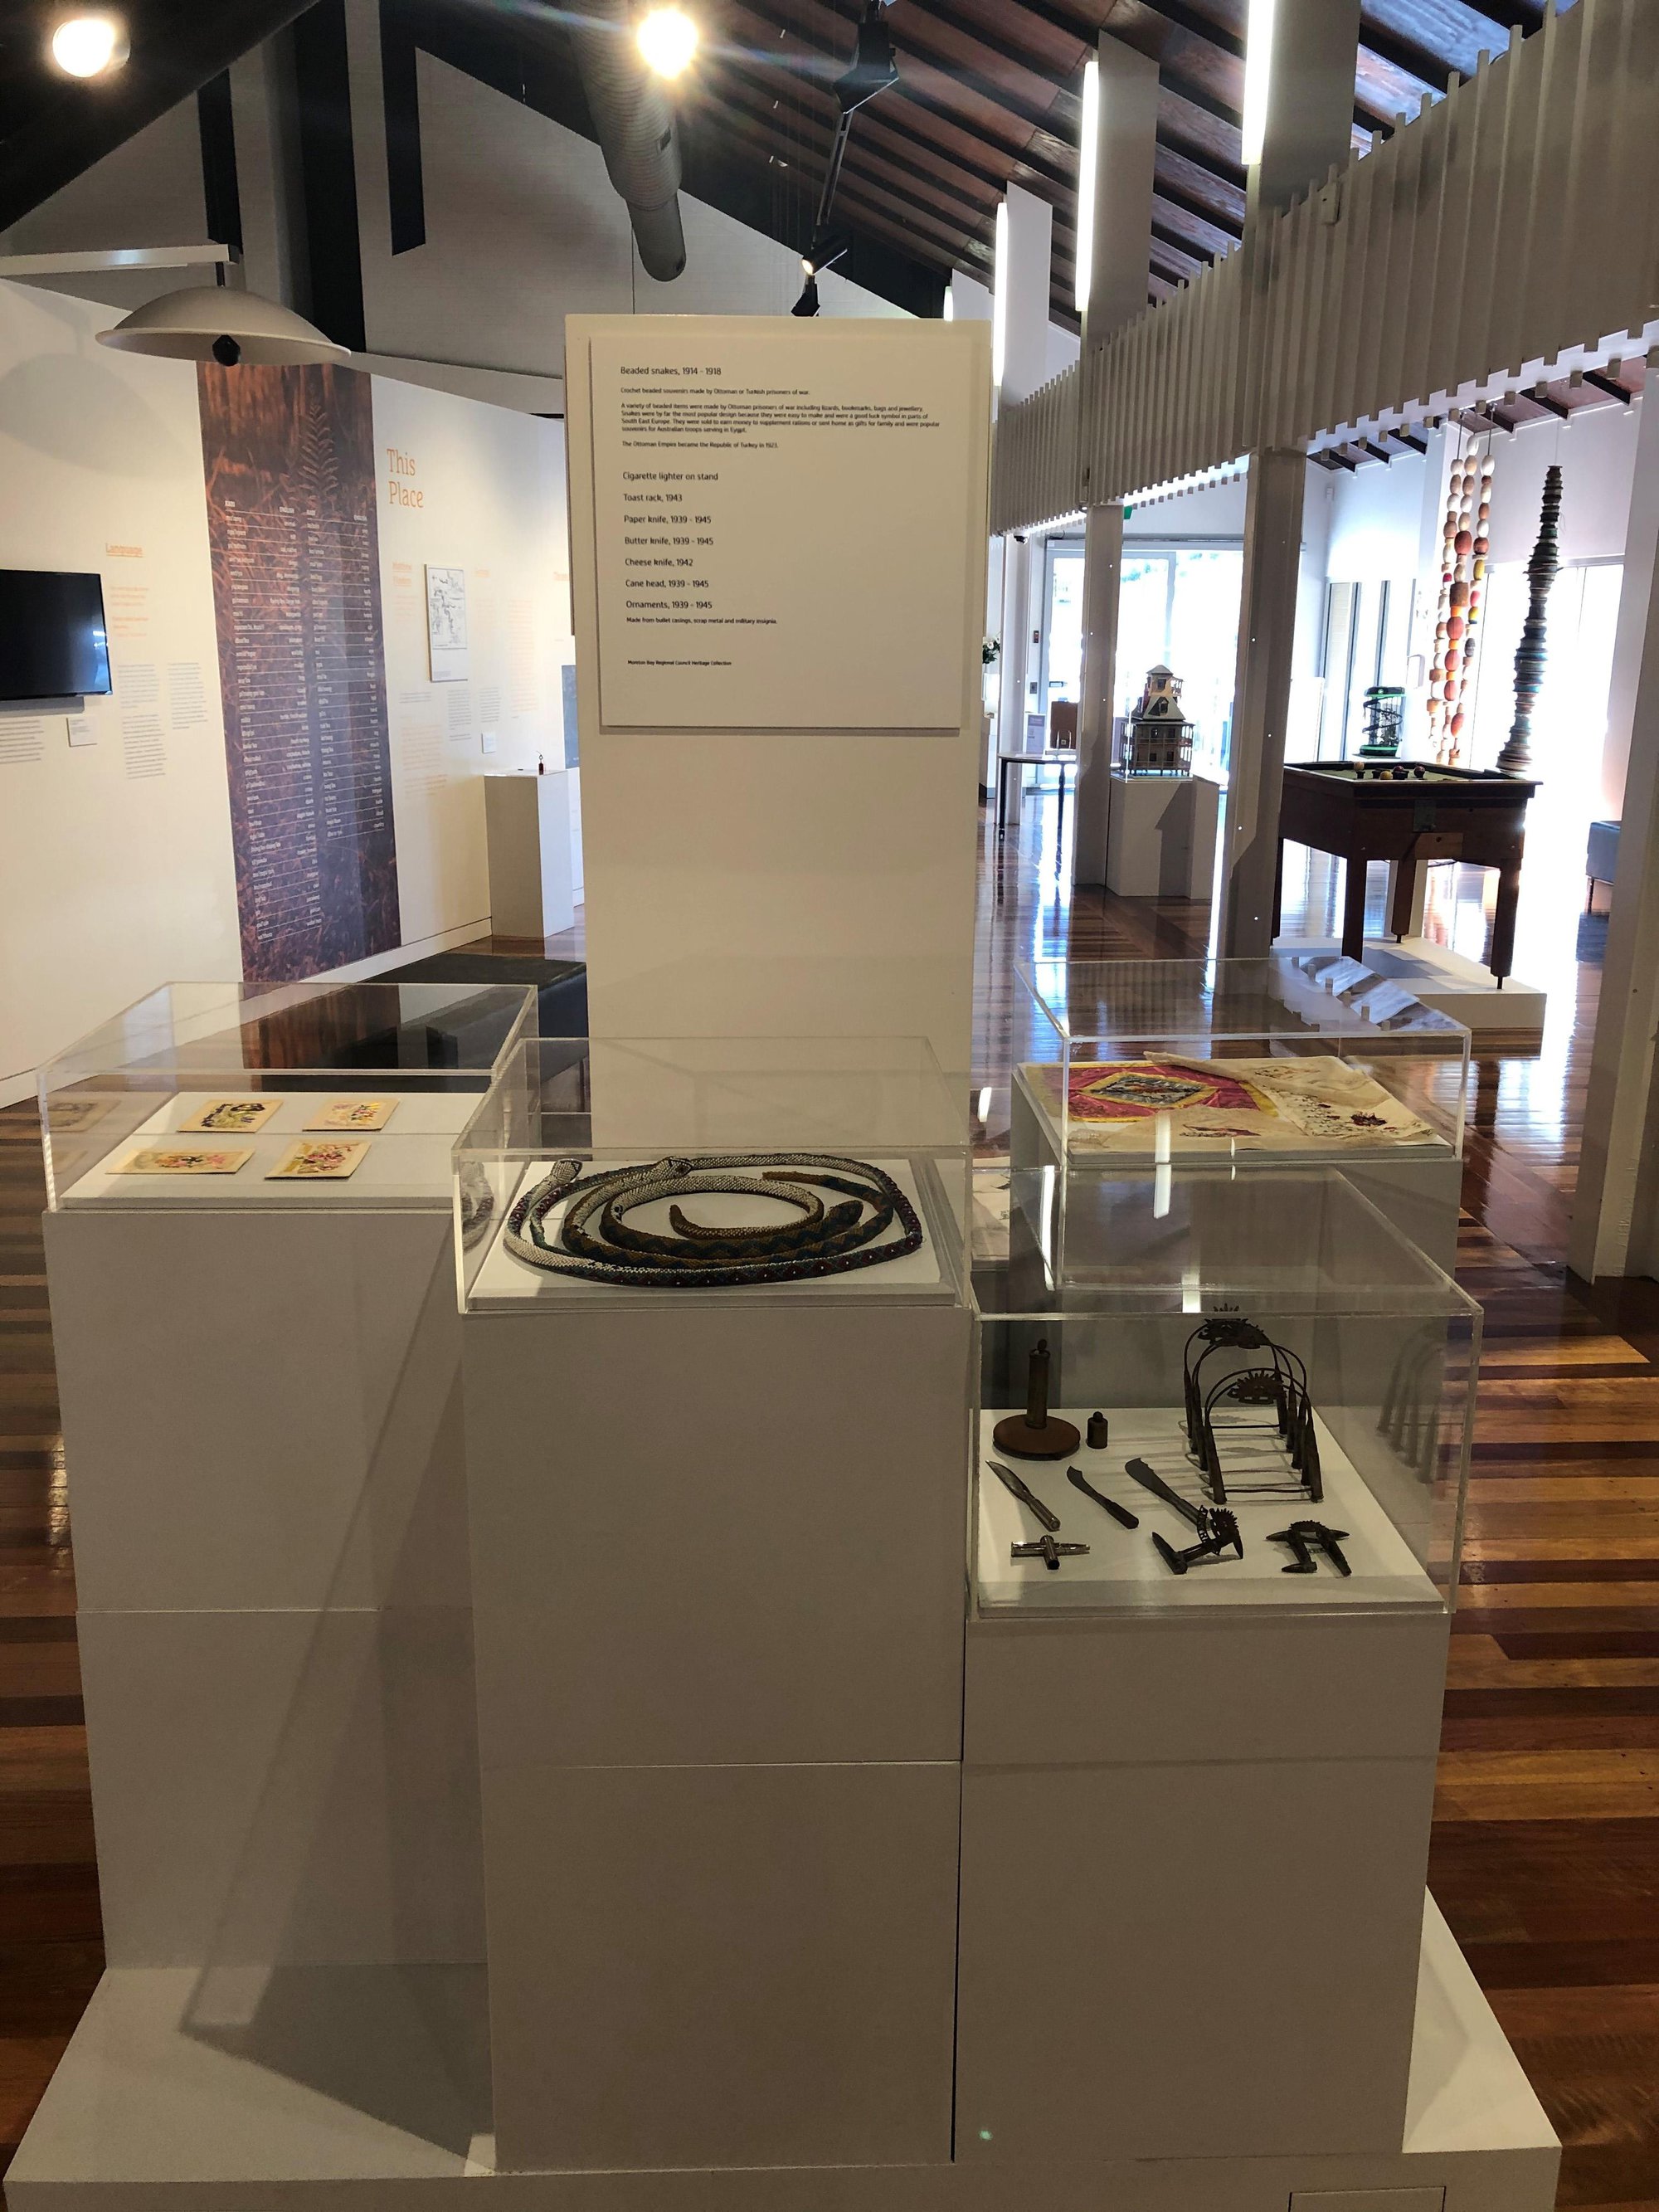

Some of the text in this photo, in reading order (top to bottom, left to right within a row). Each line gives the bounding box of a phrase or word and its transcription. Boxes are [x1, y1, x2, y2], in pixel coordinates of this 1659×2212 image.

[620, 366, 649, 374] Beaded
[650, 366, 680, 375] snakes,
[705, 367, 721, 375] 1918
[625, 402, 645, 411] variety
[672, 417, 685, 426] They
[387, 449, 416, 475] This
[622, 471, 656, 481] Cigarette
[659, 471, 683, 482] lighter
[697, 472, 718, 480] stand
[388, 481, 424, 508] Place
[623, 493, 682, 502] Toast rack, 1943
[624, 514, 645, 524] Paper
[647, 514, 669, 524] knife,
[670, 514, 688, 524] 1939
[694, 515, 711, 524] 1945
[624, 536, 647, 544] Butter
[649, 536, 670, 545] knife,
[672, 536, 689, 545] 1939
[696, 537, 713, 545] 1945
[625, 558, 693, 567] Cheese knife, 1942
[625, 579, 644, 587] Cane
[645, 579, 666, 587] head,
[668, 579, 685, 587] 1939
[692, 579, 708, 587] 1945
[625, 600, 669, 609] Ornaments,
[671, 600, 688, 609] 1939
[695, 601, 712, 609] 1945
